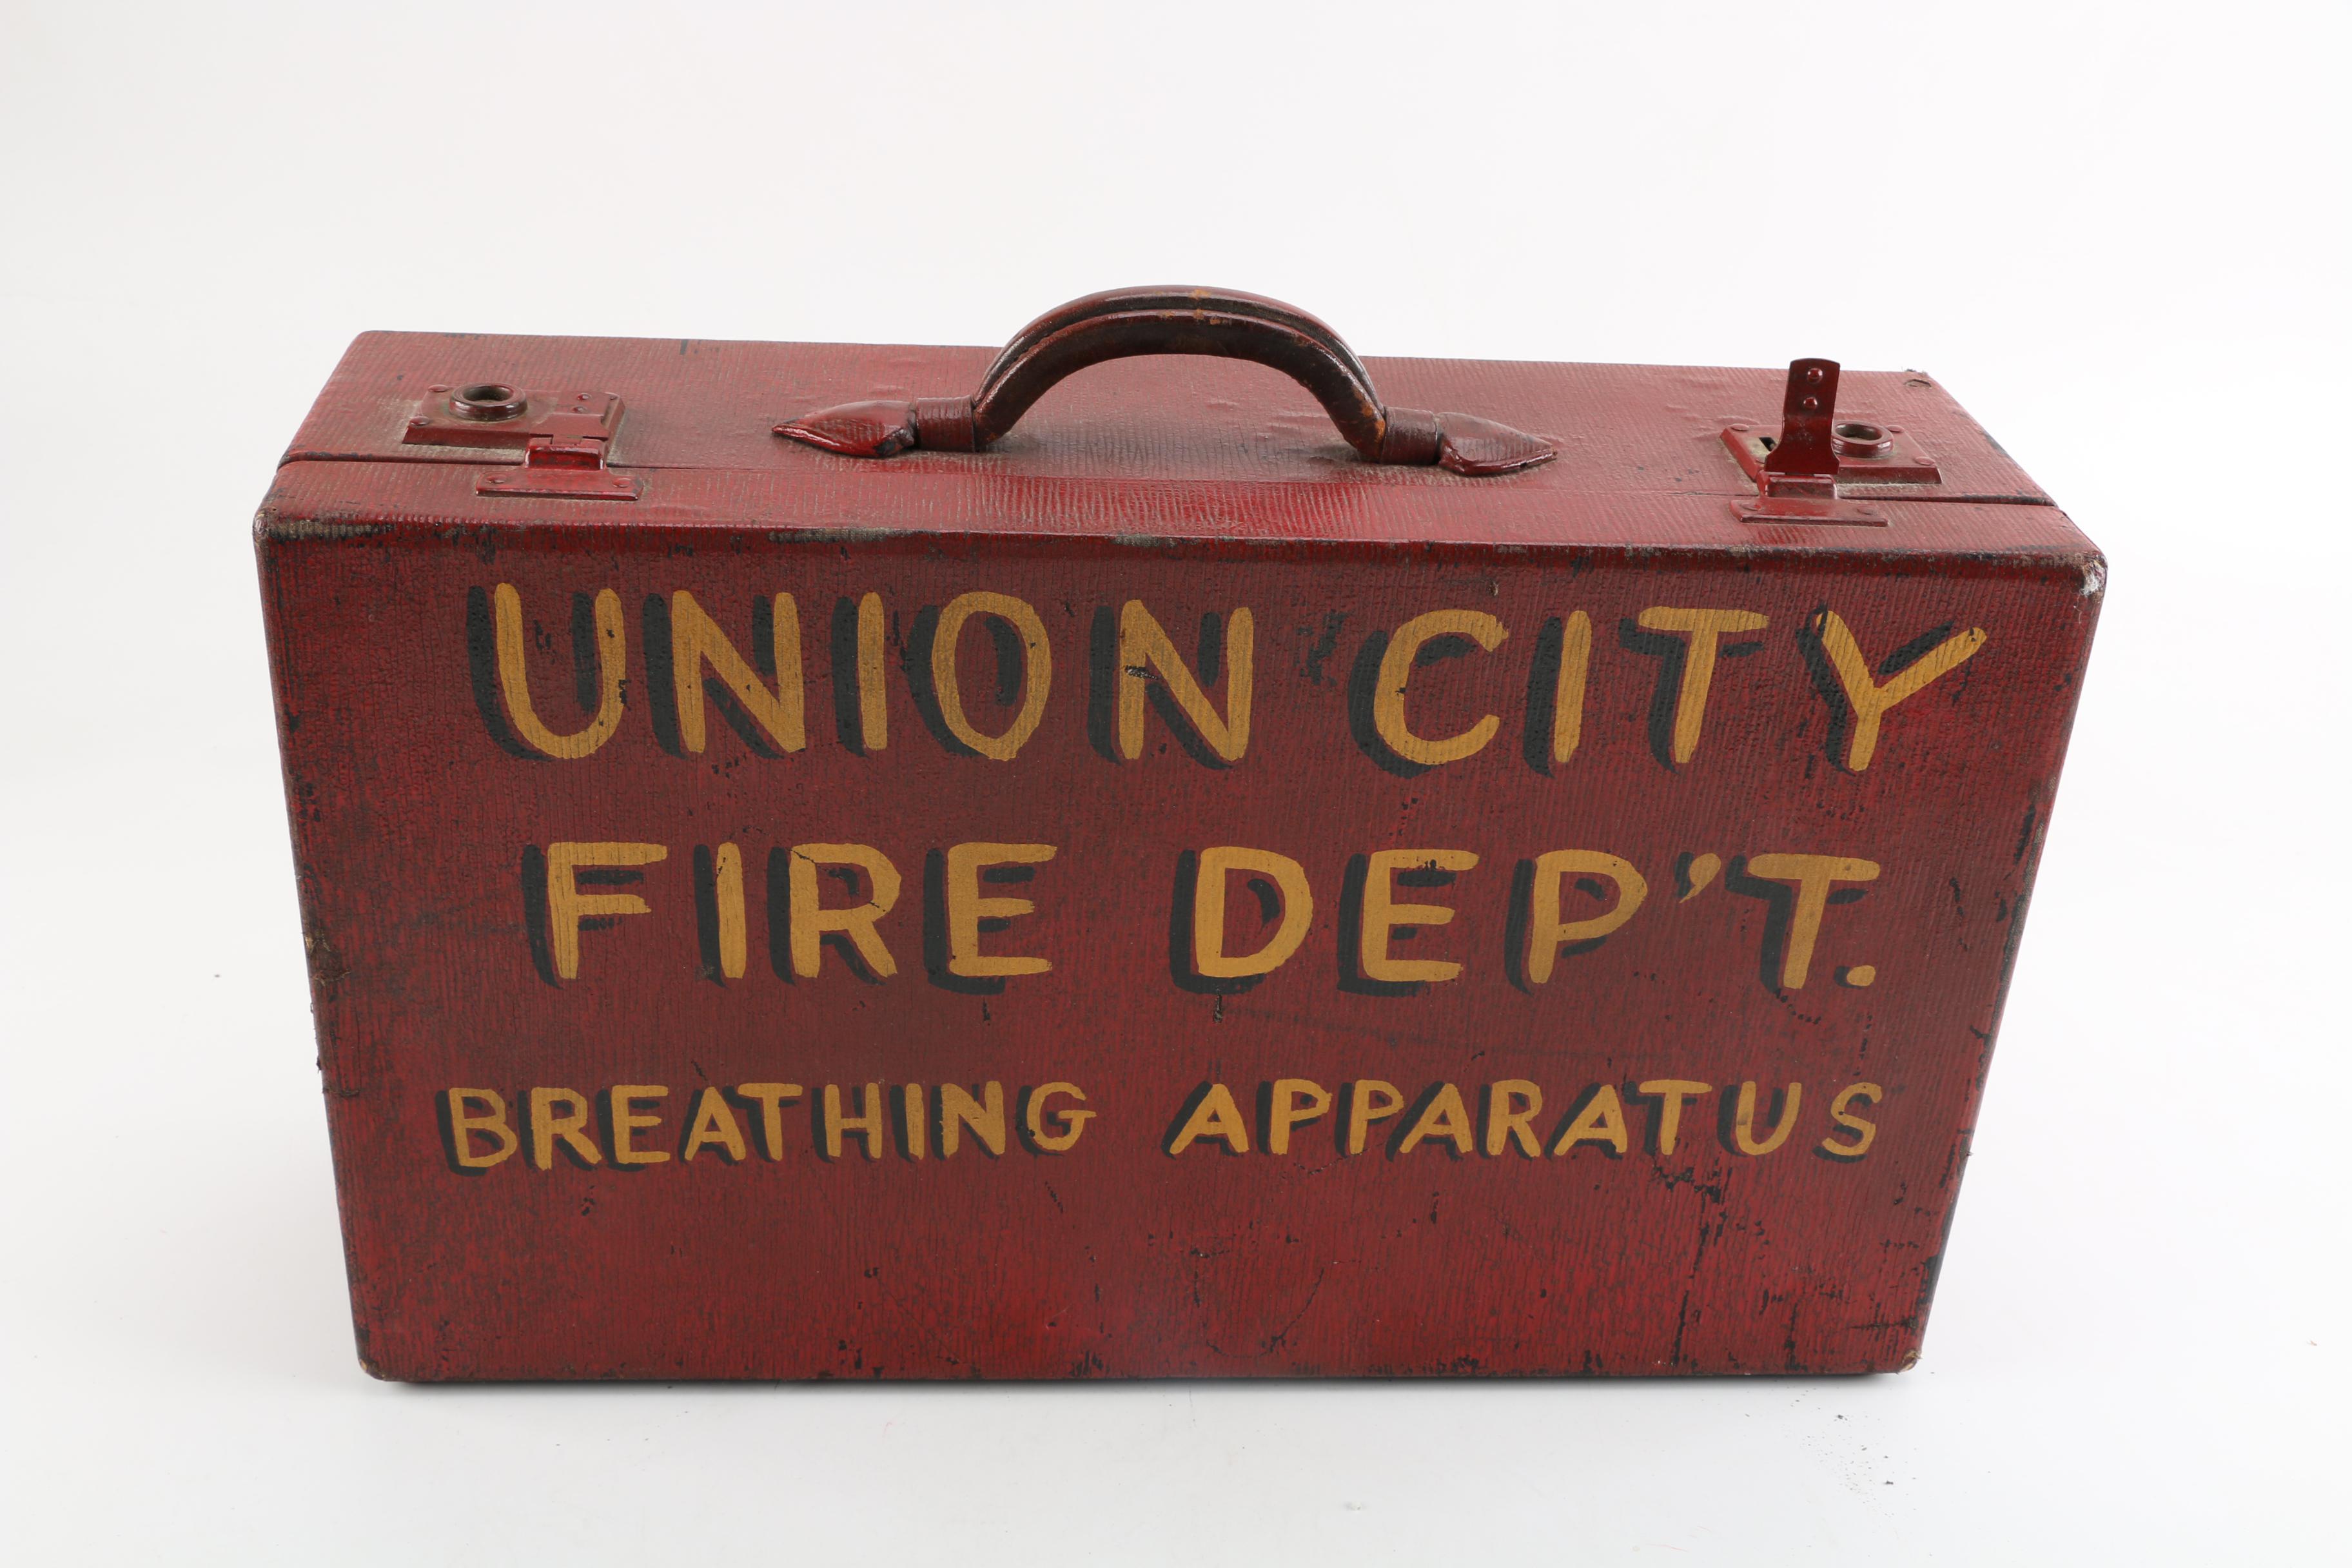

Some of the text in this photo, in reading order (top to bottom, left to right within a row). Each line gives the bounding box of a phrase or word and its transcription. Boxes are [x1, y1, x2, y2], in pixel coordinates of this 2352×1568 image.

[493, 582, 1988, 772] UNION CITY
[544, 841, 1882, 989] FIRE DEP'T.
[447, 1077, 1883, 1170] BREATHING APPARATUS
